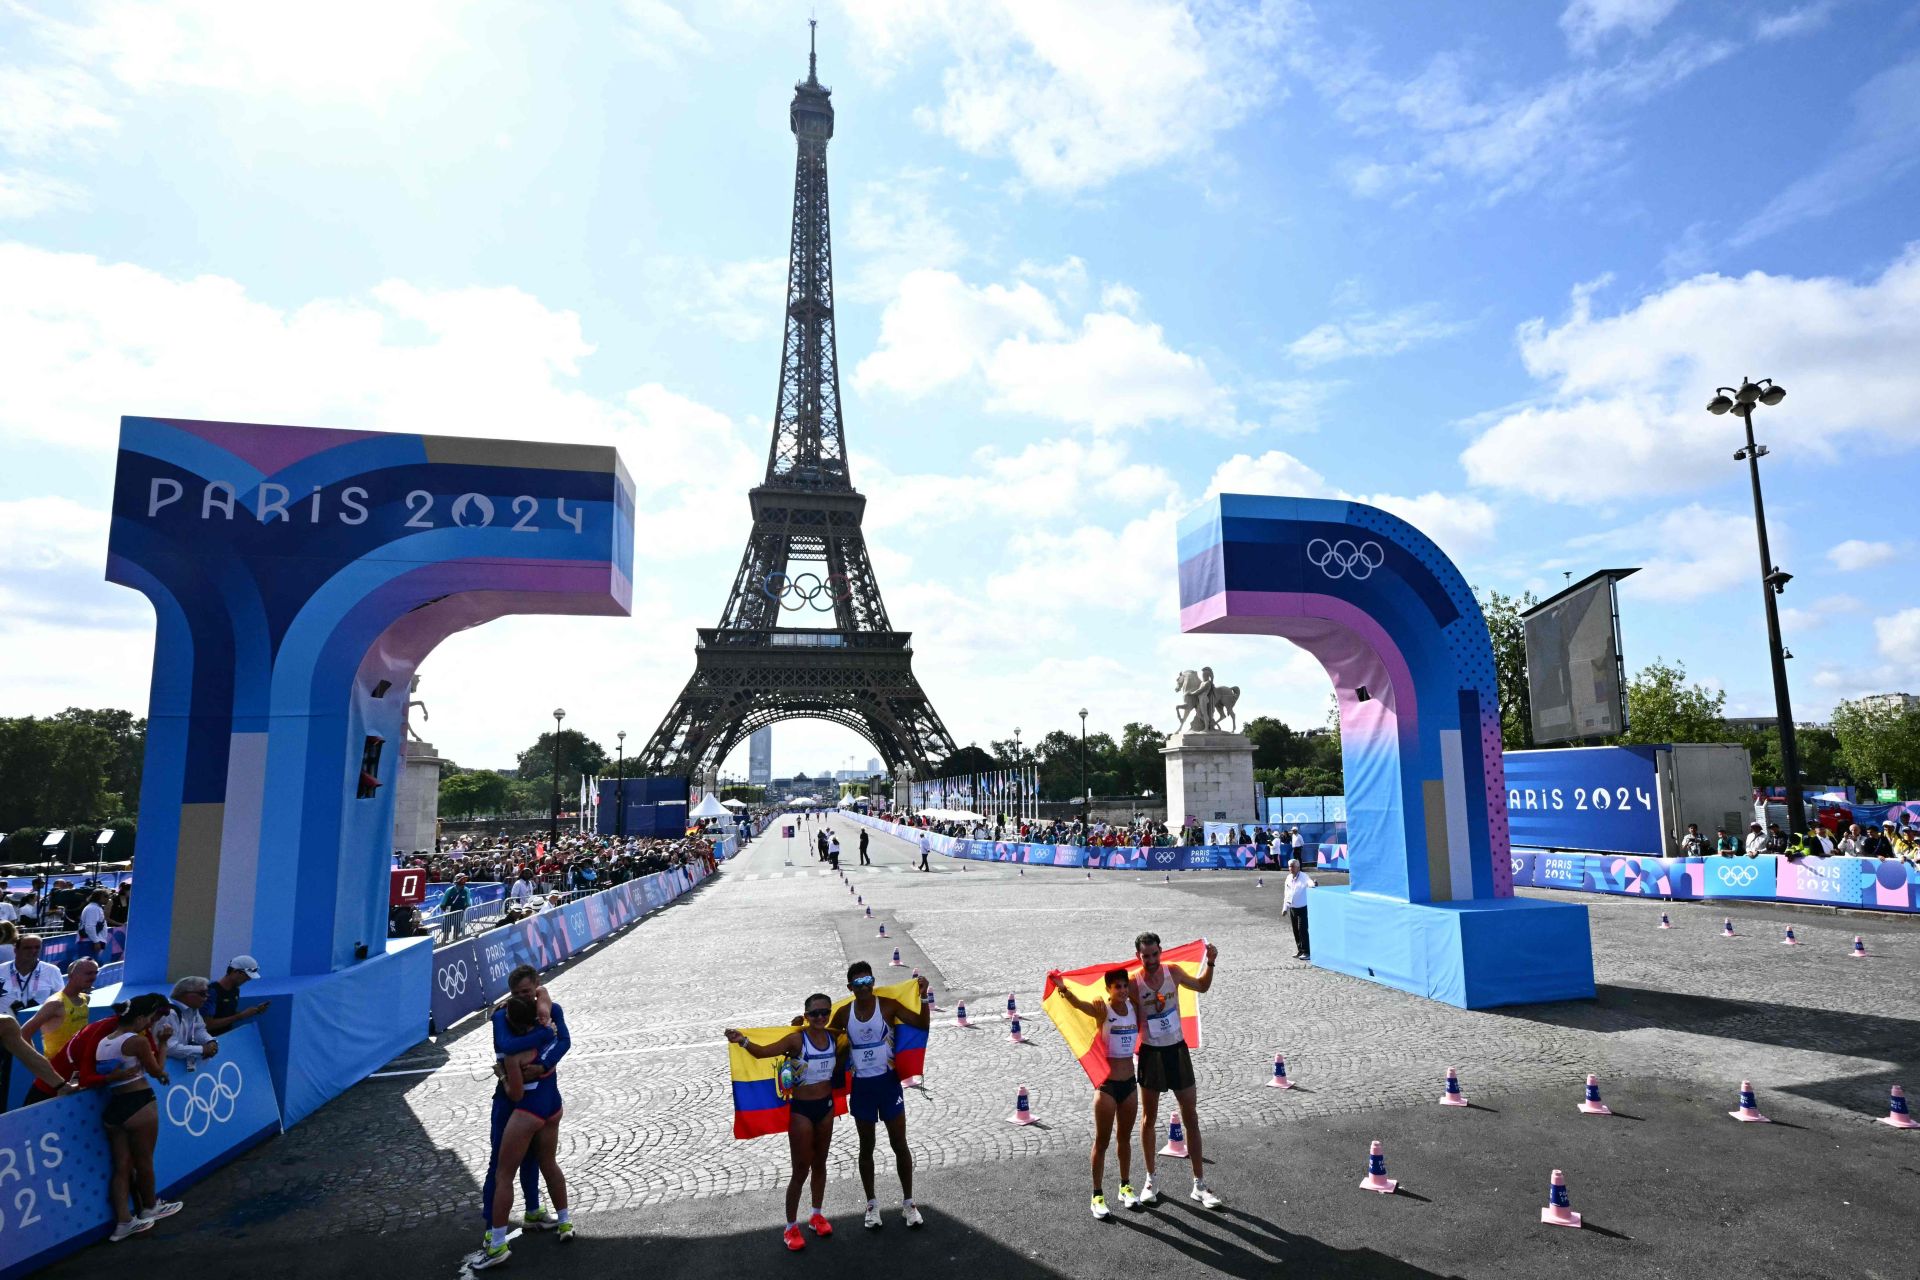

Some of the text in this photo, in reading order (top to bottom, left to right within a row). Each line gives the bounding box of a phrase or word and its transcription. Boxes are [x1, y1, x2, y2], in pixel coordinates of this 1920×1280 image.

[147, 477, 583, 534] PARIS 2024
[1574, 787, 1652, 810] 2024
[1190, 856, 1210, 864] 2024
[1545, 859, 1573, 870] PARIS
[1545, 869, 1572, 880] 2024
[1797, 865, 1840, 879] PARIS
[401, 875, 418, 897] 0
[1797, 879, 1841, 893] 2024
[485, 941, 506, 964] PARIS
[490, 960, 510, 982] 2024
[1160, 1018, 1170, 1027] 33
[863, 1050, 874, 1059] 29
[820, 1060, 830, 1069] 117
[0, 1178, 72, 1232] 24
